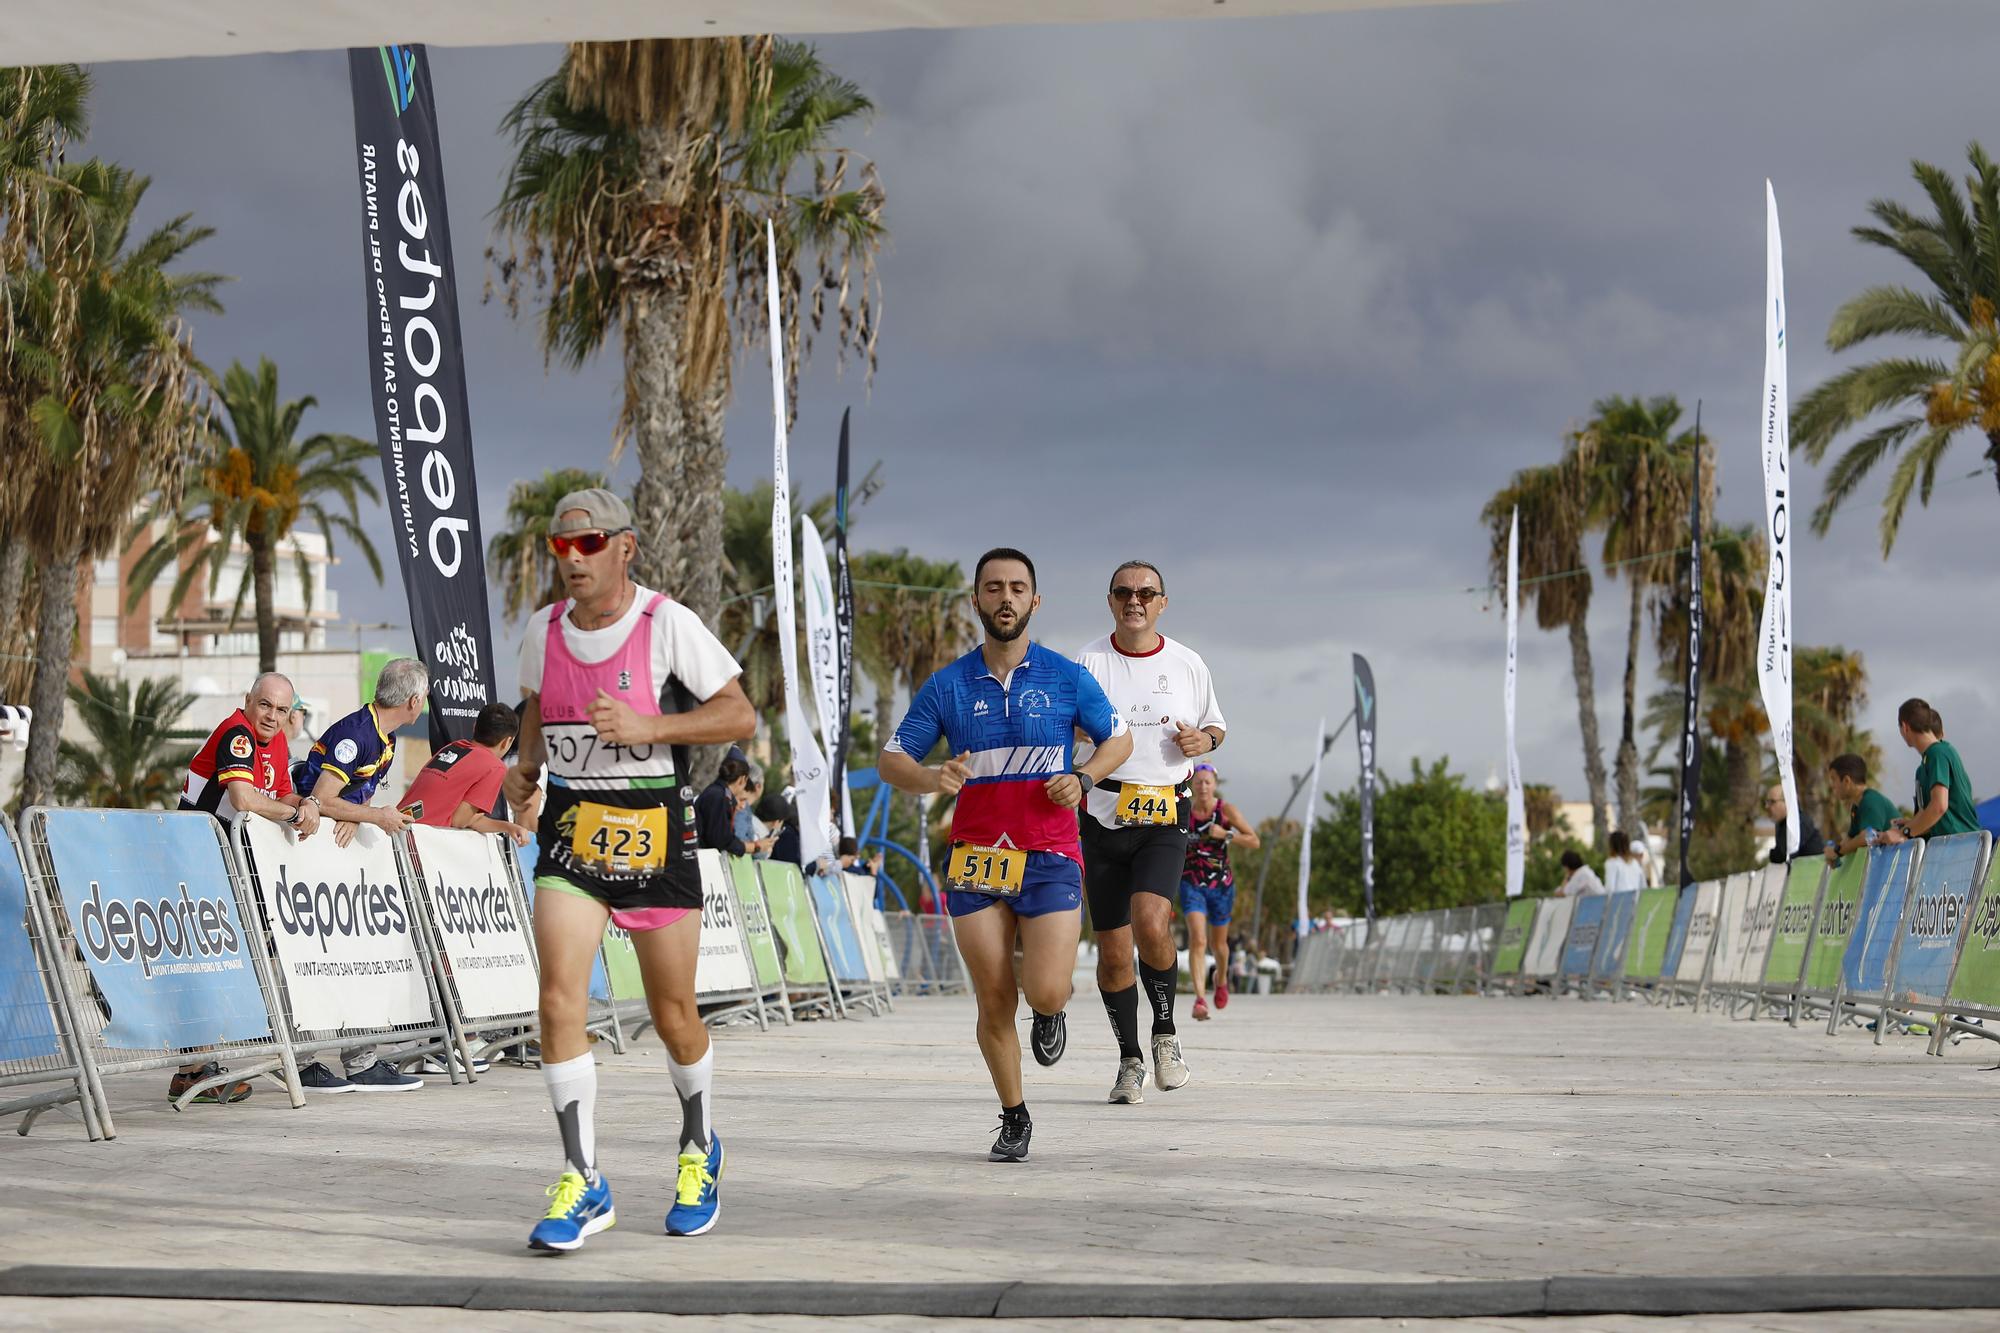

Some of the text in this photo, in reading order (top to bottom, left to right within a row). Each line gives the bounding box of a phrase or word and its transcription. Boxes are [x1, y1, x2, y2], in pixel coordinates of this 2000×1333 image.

[1127, 797, 1168, 817] 444
[589, 826, 652, 857] 423
[963, 855, 1009, 881] 511
[275, 864, 407, 954] deportes
[435, 871, 517, 949] deportes
[81, 880, 240, 979] deportes
[340, 962, 354, 976] SAN
[372, 961, 386, 975] DEL
